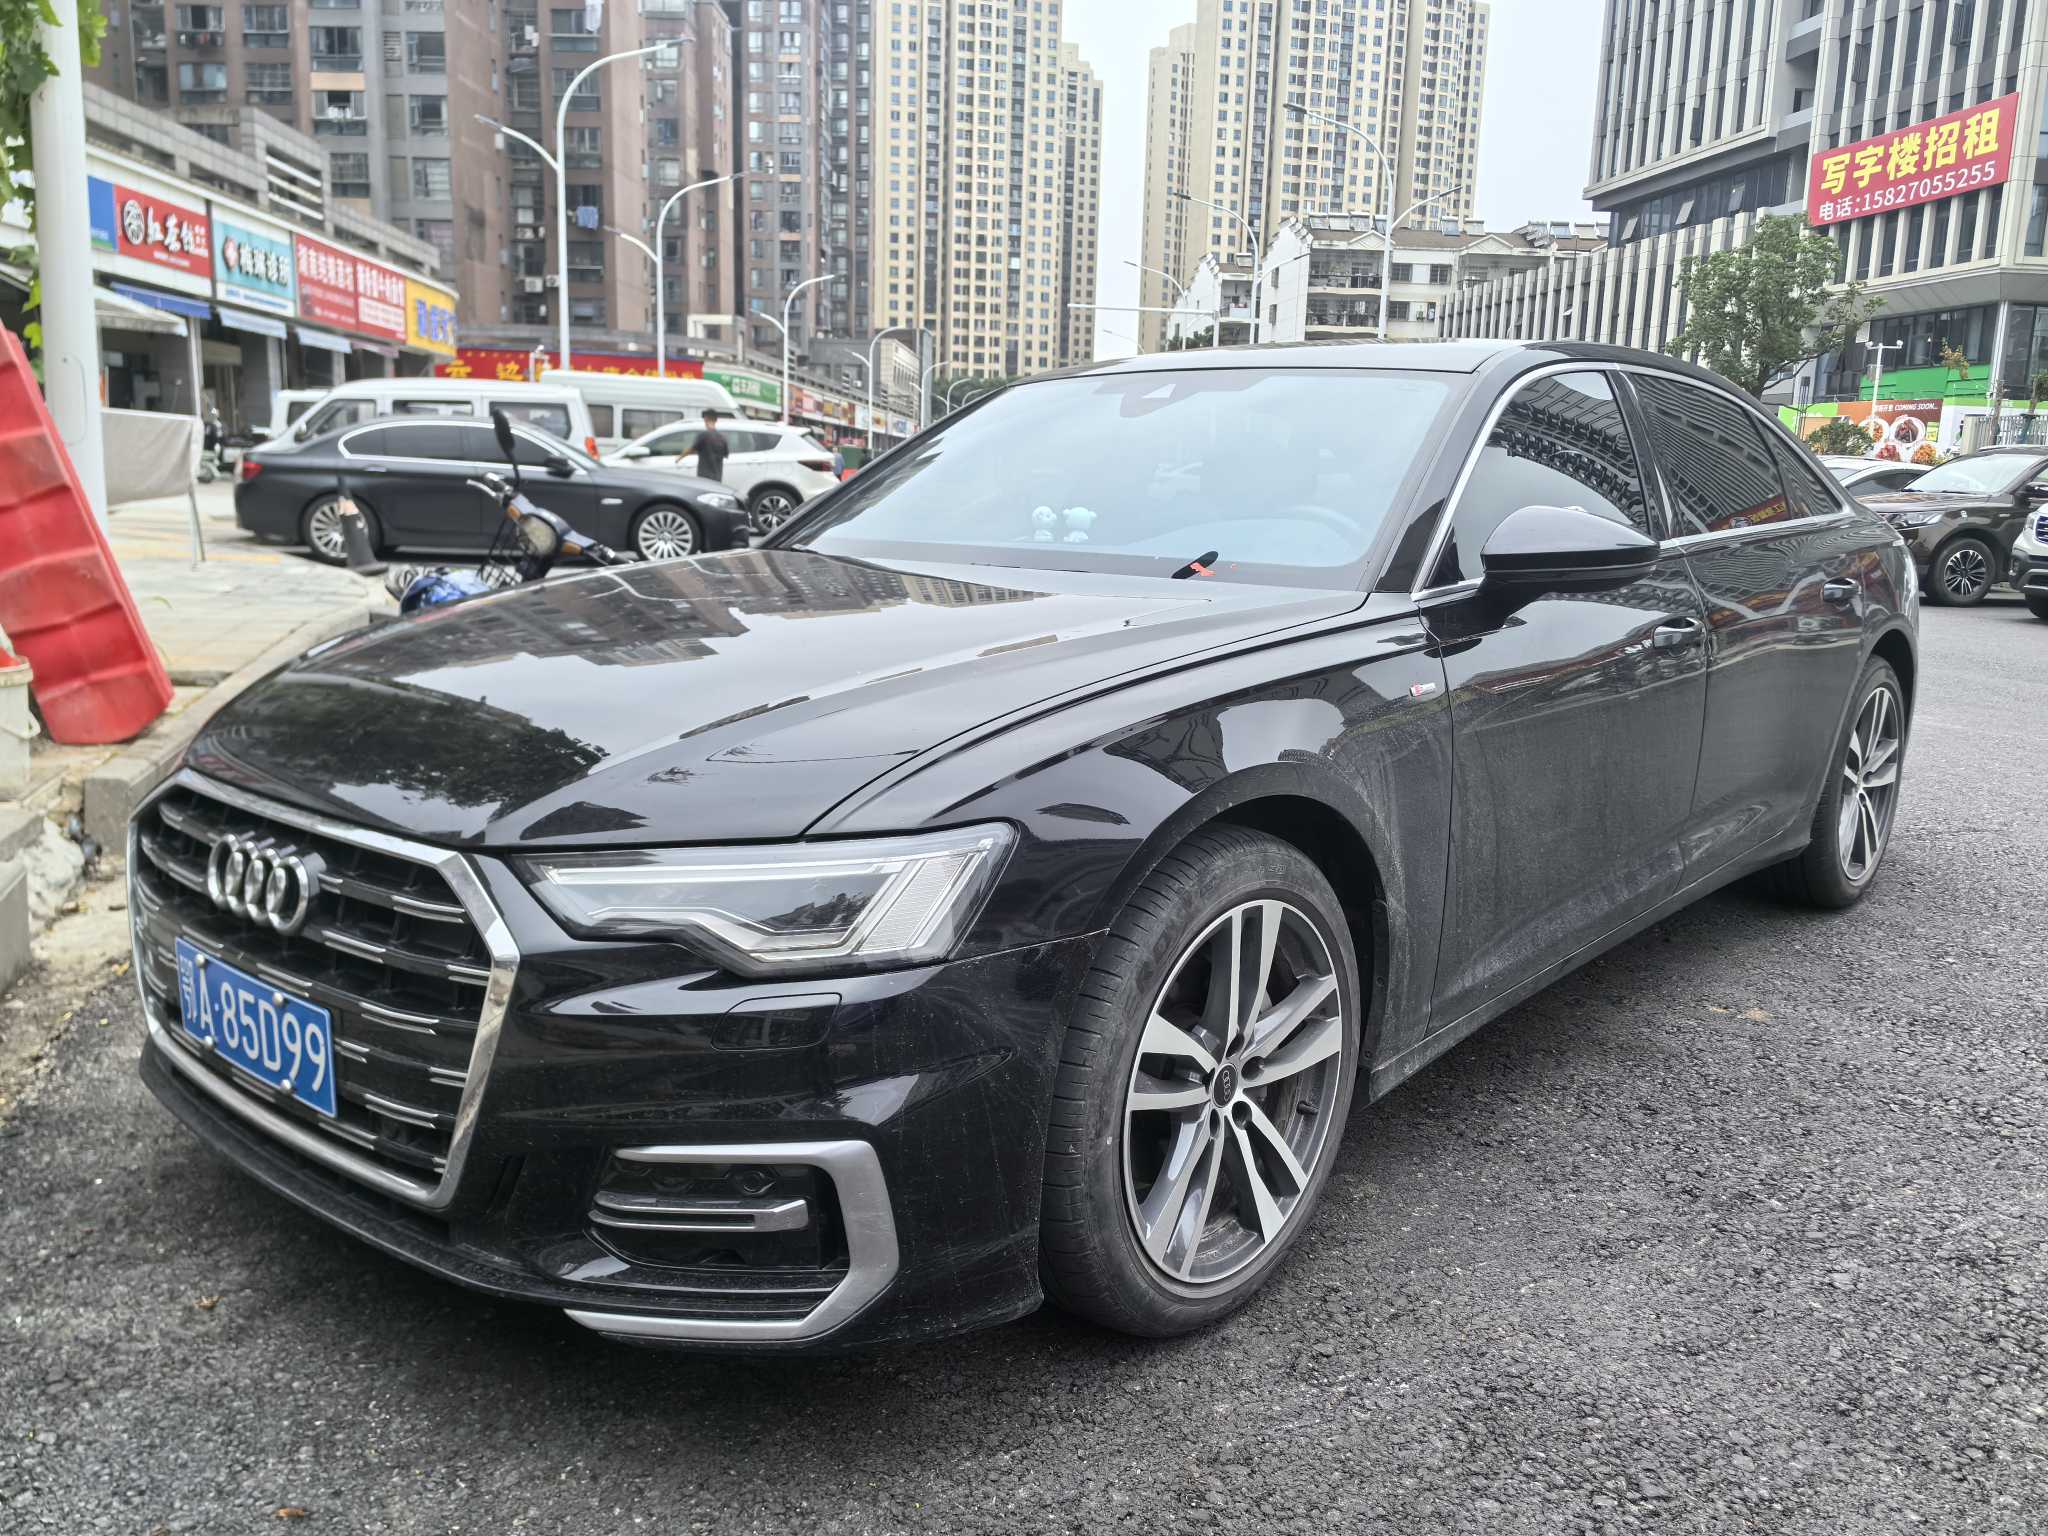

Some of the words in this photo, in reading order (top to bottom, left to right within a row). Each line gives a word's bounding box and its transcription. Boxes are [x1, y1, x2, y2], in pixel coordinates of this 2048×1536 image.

[1820, 107, 2001, 195] 写字楼招租
[1894, 403, 1917, 411] COMING
